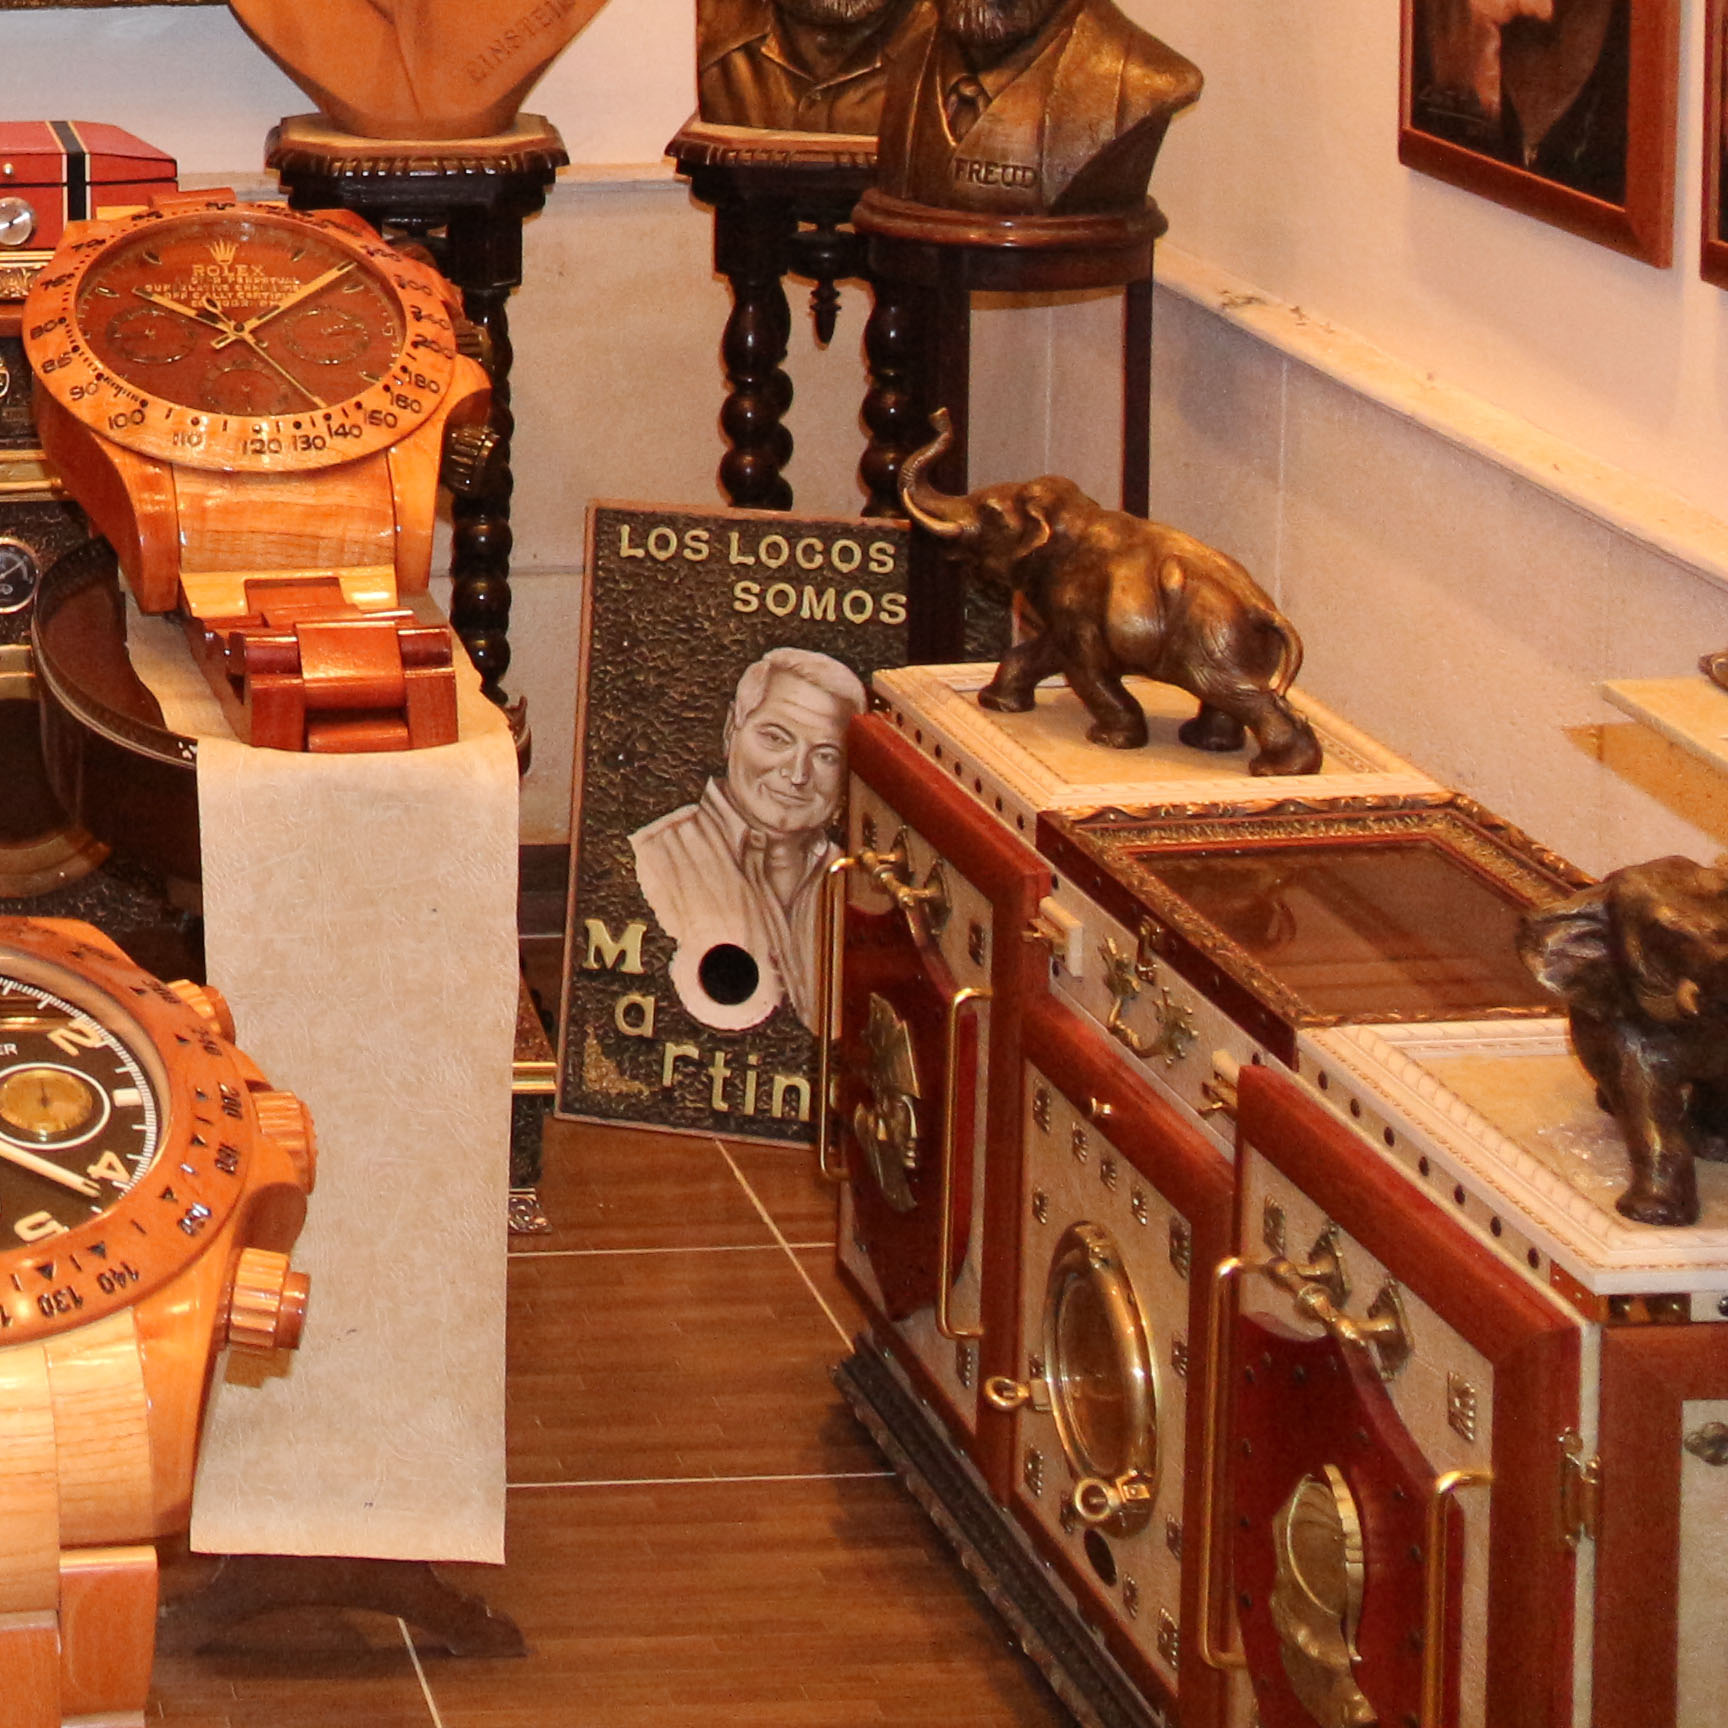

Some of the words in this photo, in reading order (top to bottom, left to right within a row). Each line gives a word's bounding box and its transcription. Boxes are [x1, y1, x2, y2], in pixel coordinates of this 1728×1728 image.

[953, 156, 1038, 189] FREUD
[191, 263, 266, 277] ROLEX
[107, 408, 146, 431] 100
[327, 422, 364, 440] 140
[242, 438, 283, 455] 120
[293, 435, 327, 452] 130
[619, 524, 711, 562] LOS
[728, 530, 897, 575] LOCOS
[732, 579, 908, 625] SOMOS
[582, 917, 824, 1123] Martin
[86, 1150, 131, 1183] 4
[14, 1209, 66, 1243] 5
[96, 1260, 141, 1297] 140
[37, 1284, 85, 1319] 130
